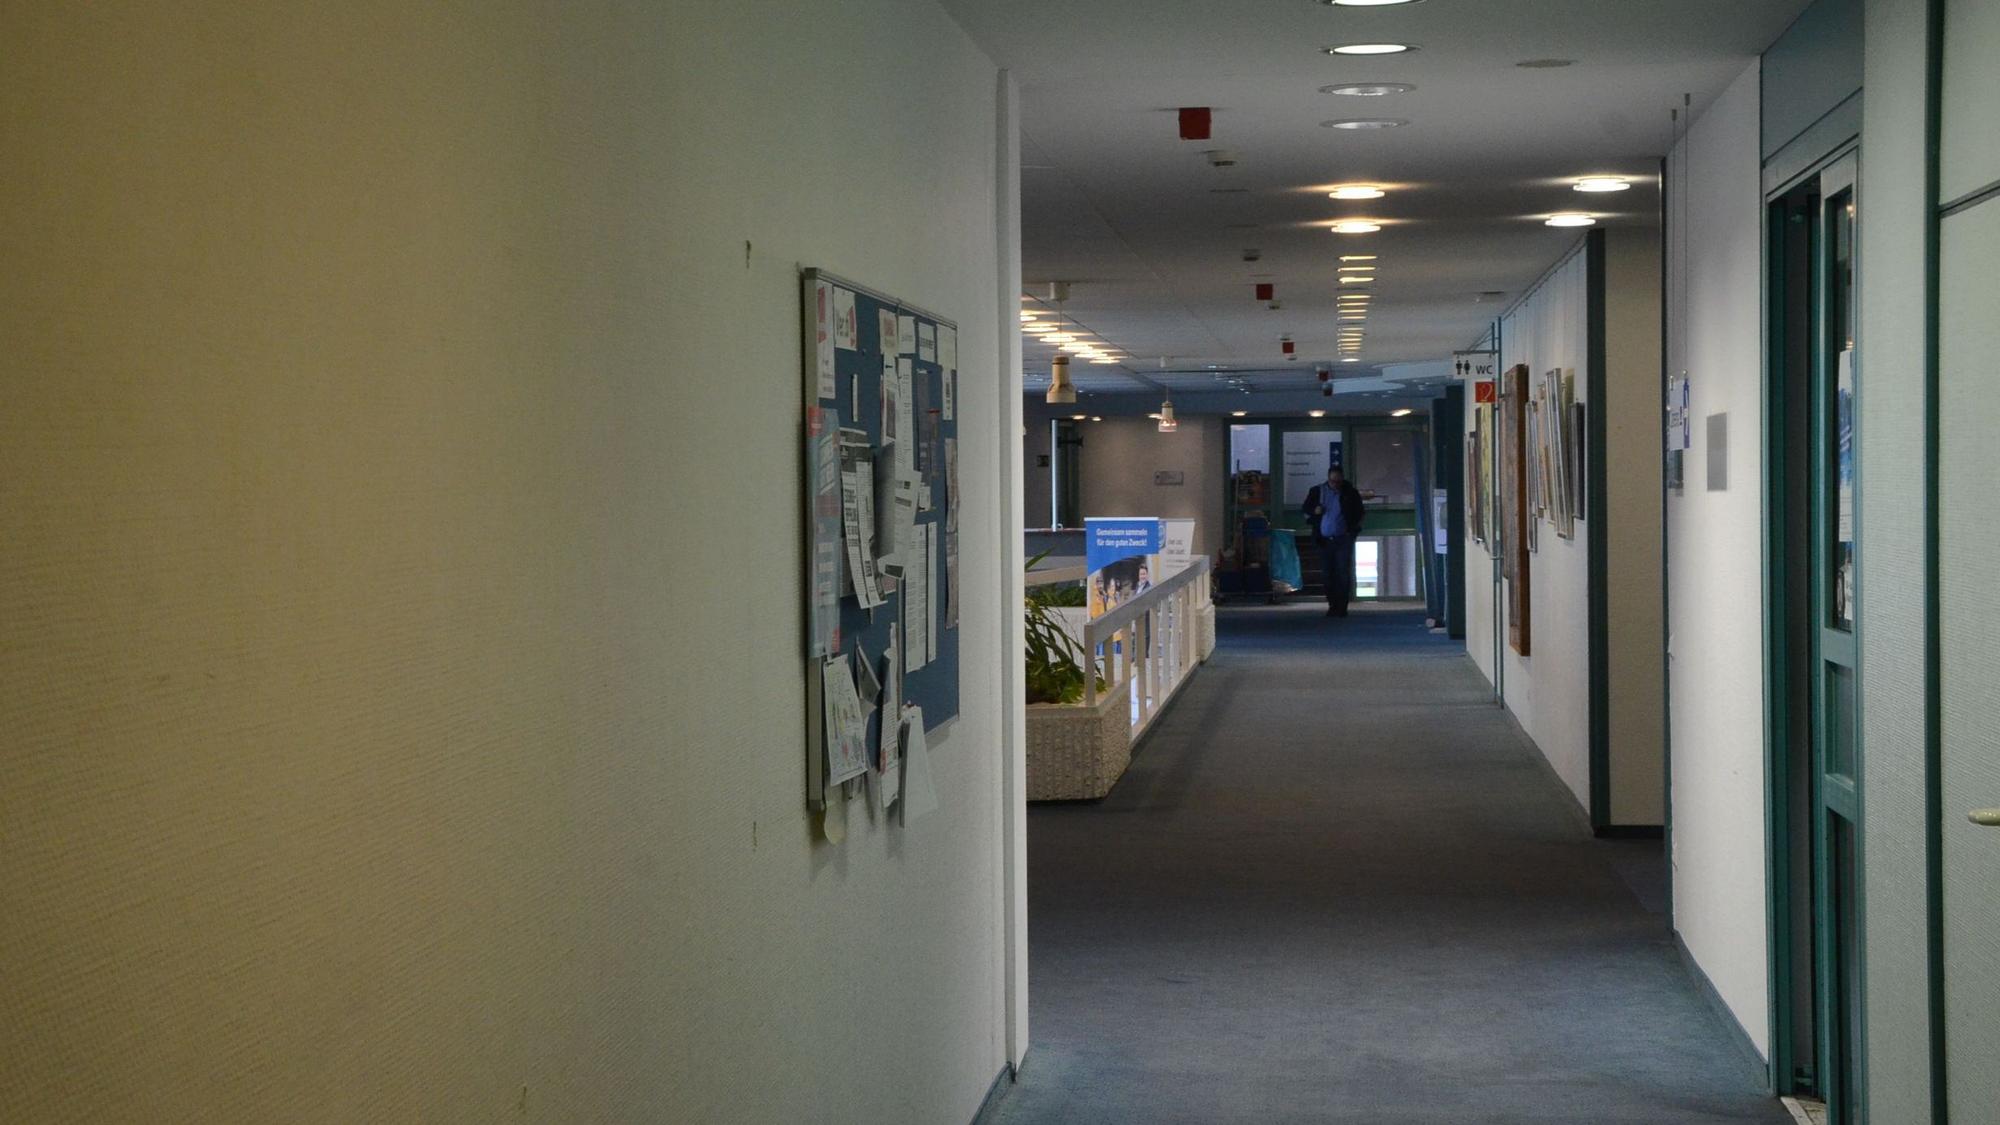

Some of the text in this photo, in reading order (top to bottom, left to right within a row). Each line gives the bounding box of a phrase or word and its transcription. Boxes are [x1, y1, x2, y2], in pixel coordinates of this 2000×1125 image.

[1476, 364, 1493, 375] WC
[1096, 528, 1148, 536] Gemeinsam sammeln
[1115, 540, 1129, 548] guten
